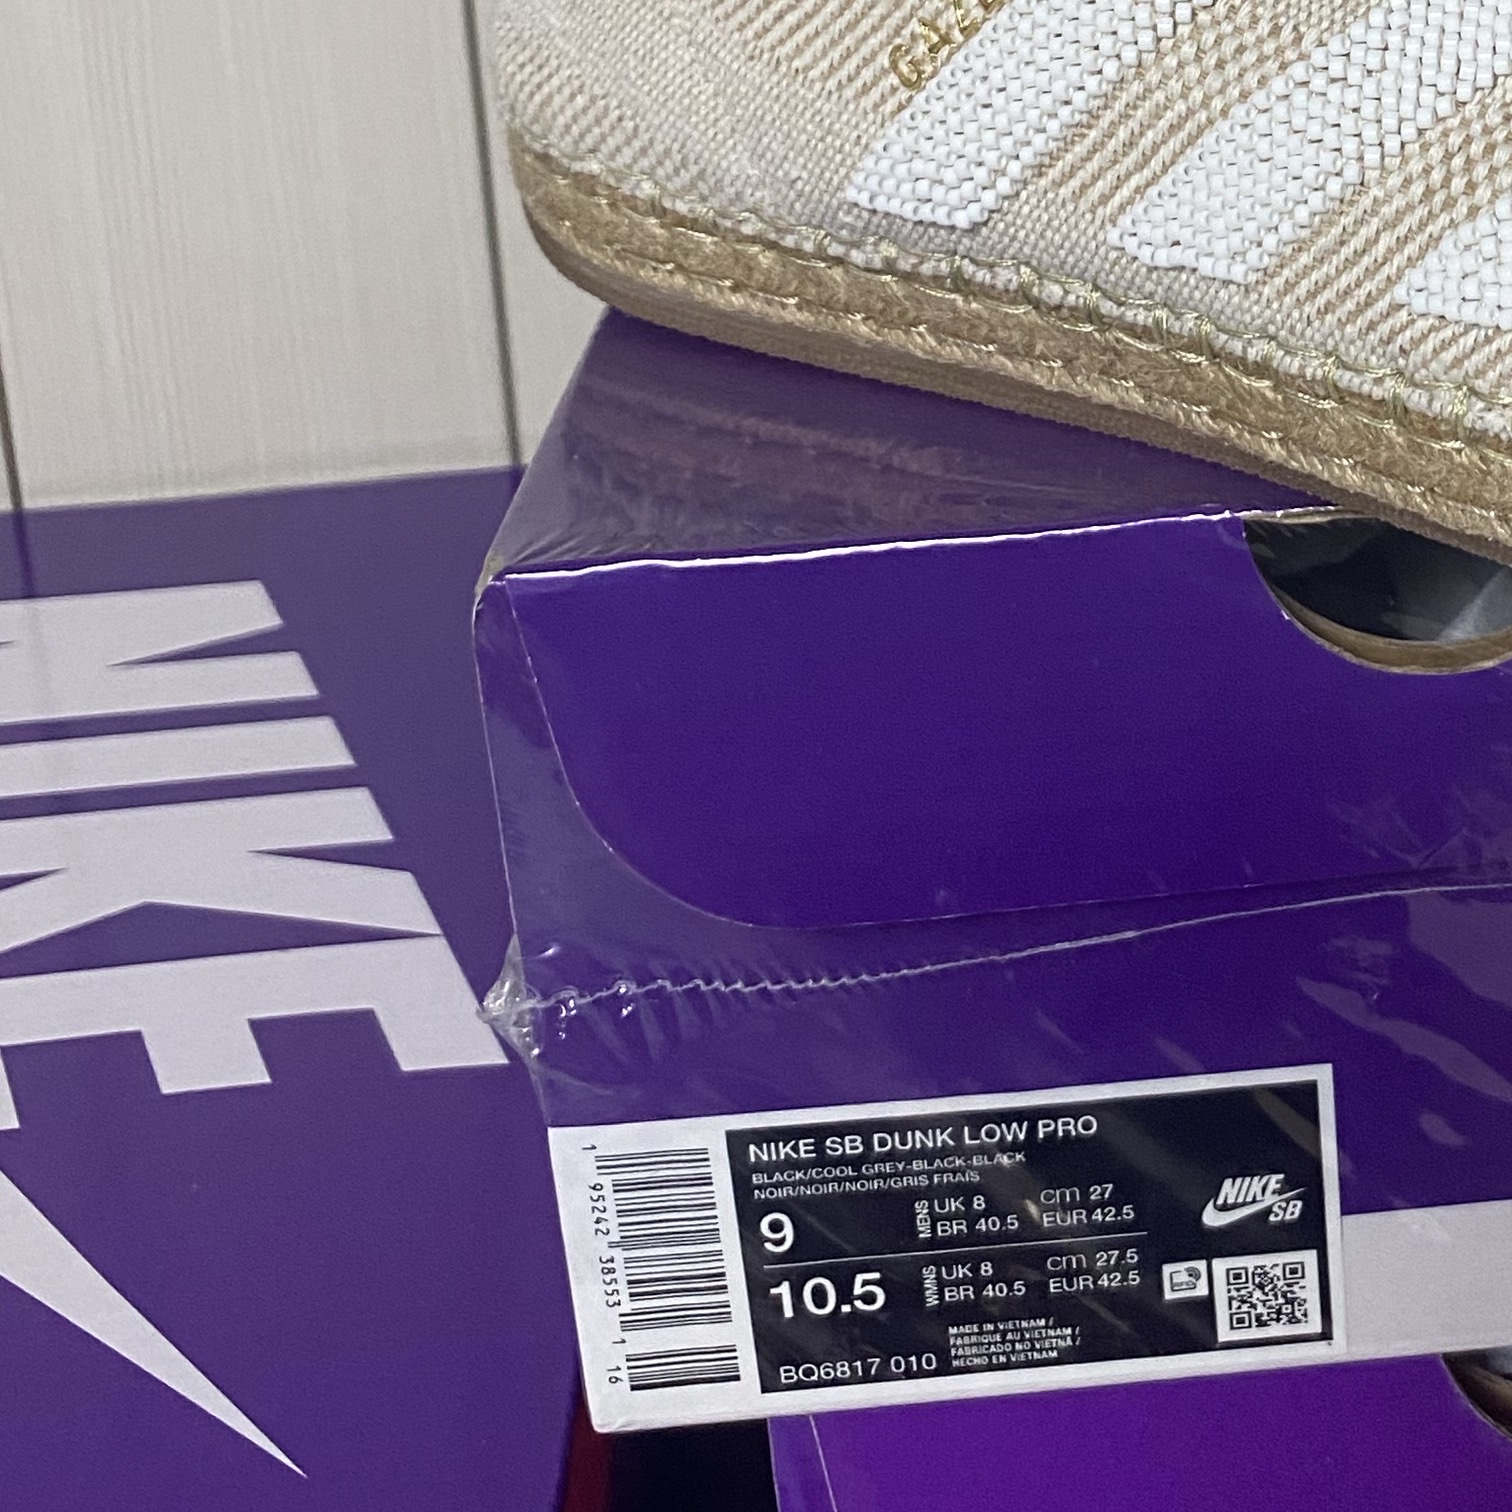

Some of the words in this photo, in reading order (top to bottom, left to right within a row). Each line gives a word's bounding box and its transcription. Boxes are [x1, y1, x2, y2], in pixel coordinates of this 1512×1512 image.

[748, 1138, 816, 1163] NIKE
[825, 1135, 864, 1156] SB
[873, 1127, 955, 1153] DUNK
[963, 1121, 1028, 1146] LOW
[1038, 1114, 1098, 1139] PRO
[752, 1165, 858, 1184] BLACK/COOL
[862, 1151, 1026, 1175] GREY-BLACK-BLACK
[753, 1173, 929, 1200] NOIR/NOIR/NOIR/GRIS
[1089, 1183, 1114, 1201] 27
[1215, 1173, 1286, 1206] NIKE
[588, 1183, 611, 1236] 95242
[934, 1196, 965, 1214] UK
[972, 1194, 986, 1211] 8
[1268, 1199, 1303, 1222] SB
[914, 1199, 932, 1238] MENS
[936, 1219, 968, 1237] BR
[975, 1214, 1019, 1232] 40.5
[1042, 1208, 1087, 1228] EUR
[1091, 1204, 1135, 1222] 42.5
[759, 1211, 795, 1254] 9
[1096, 1248, 1139, 1267] 27.5
[599, 1255, 622, 1309] 38553
[941, 1262, 973, 1280] UK
[979, 1261, 993, 1277] 8
[1049, 1274, 1094, 1293] EUR
[1097, 1270, 1141, 1287] 42.5
[769, 1271, 886, 1318] 10.5
[923, 1264, 940, 1307] WMNS
[944, 1285, 975, 1302] BR
[982, 1280, 1026, 1297] 40.5
[948, 1323, 980, 1335] MADE
[982, 1322, 995, 1332] IN
[997, 1317, 1046, 1331] VIETNAM
[949, 1333, 1002, 1346] FABRIQUE
[1005, 1330, 1021, 1341] AU
[1024, 1326, 1073, 1339] VIETNAM
[950, 1342, 1013, 1357] FABRICADO
[1015, 1340, 1031, 1351] NO
[951, 1356, 989, 1368] HECHO
[991, 1353, 1007, 1364] EN
[1010, 1349, 1059, 1363] VIETNAM
[607, 1365, 624, 1385] 16
[779, 1357, 881, 1384] BQ6817
[890, 1353, 937, 1373] 010
